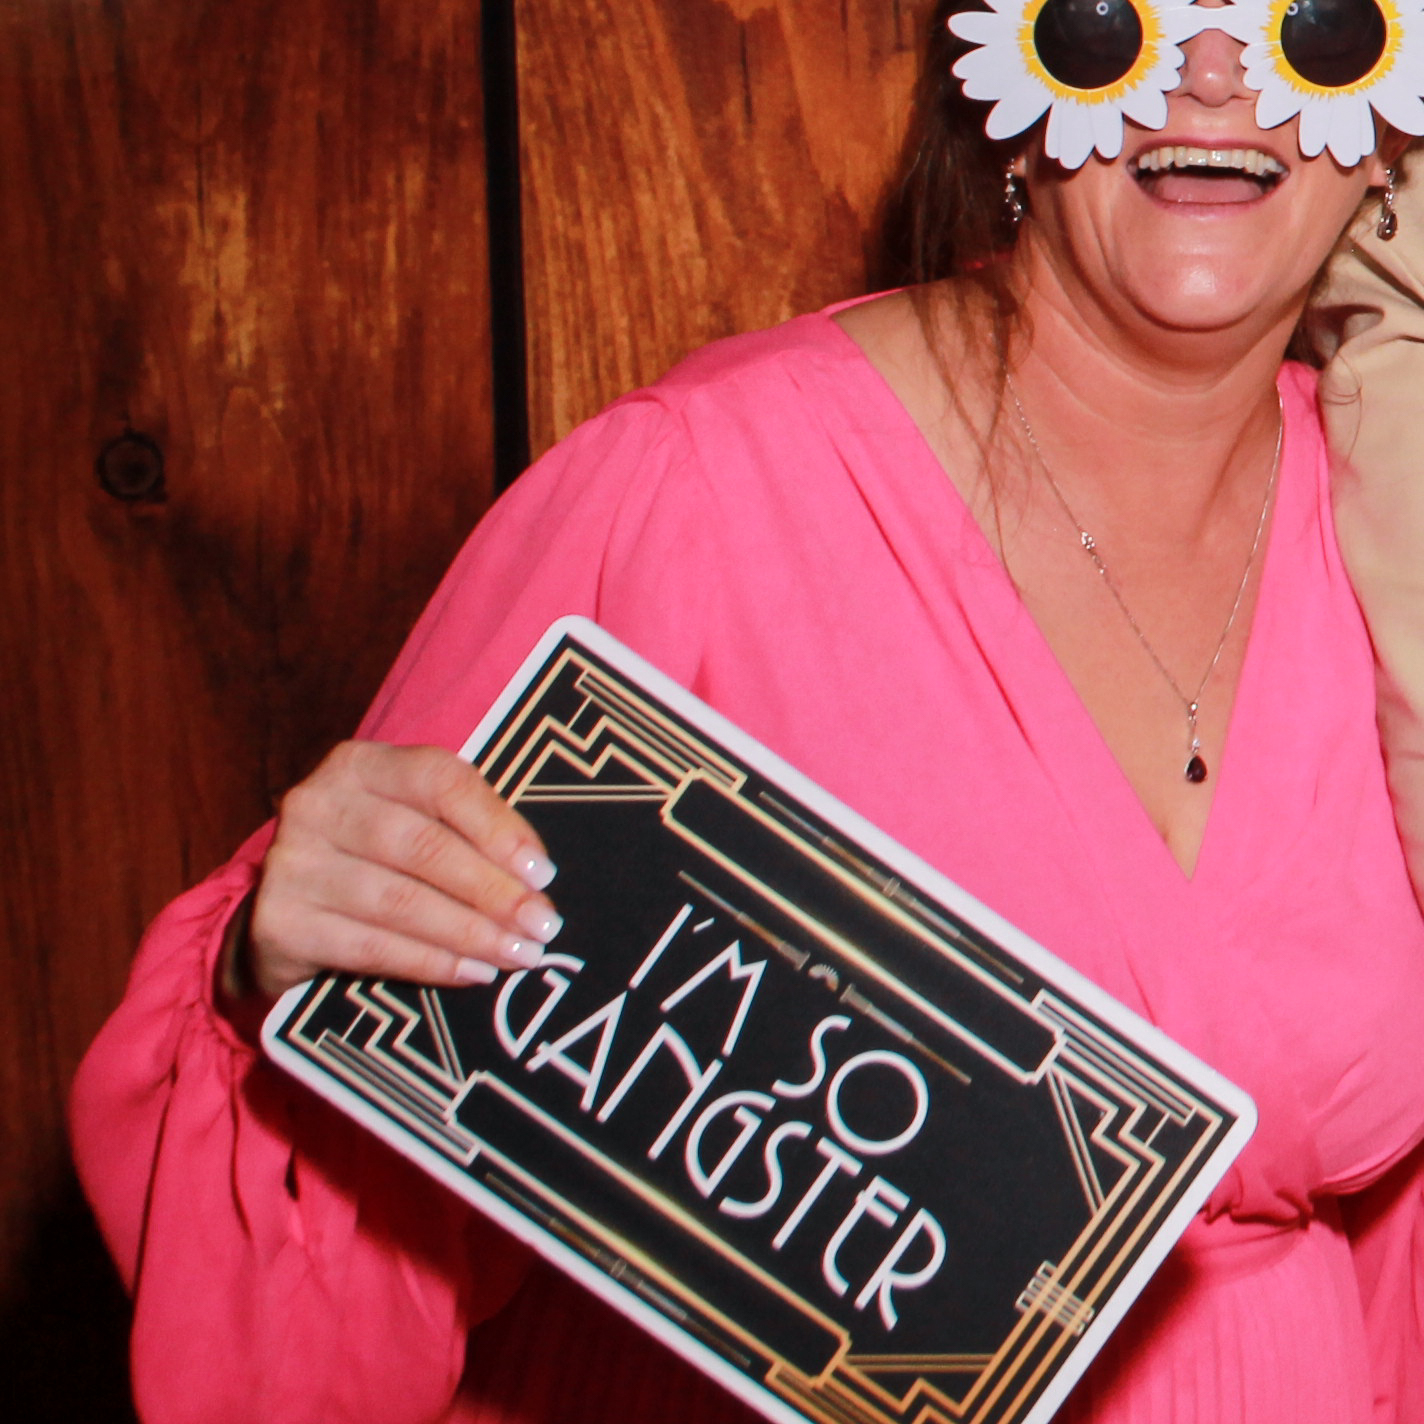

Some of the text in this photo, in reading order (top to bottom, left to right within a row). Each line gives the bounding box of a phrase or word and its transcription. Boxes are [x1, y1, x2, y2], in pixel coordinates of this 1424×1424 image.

[492, 952, 948, 1330] GANGSTER
[630, 903, 930, 1157] I'M SO
